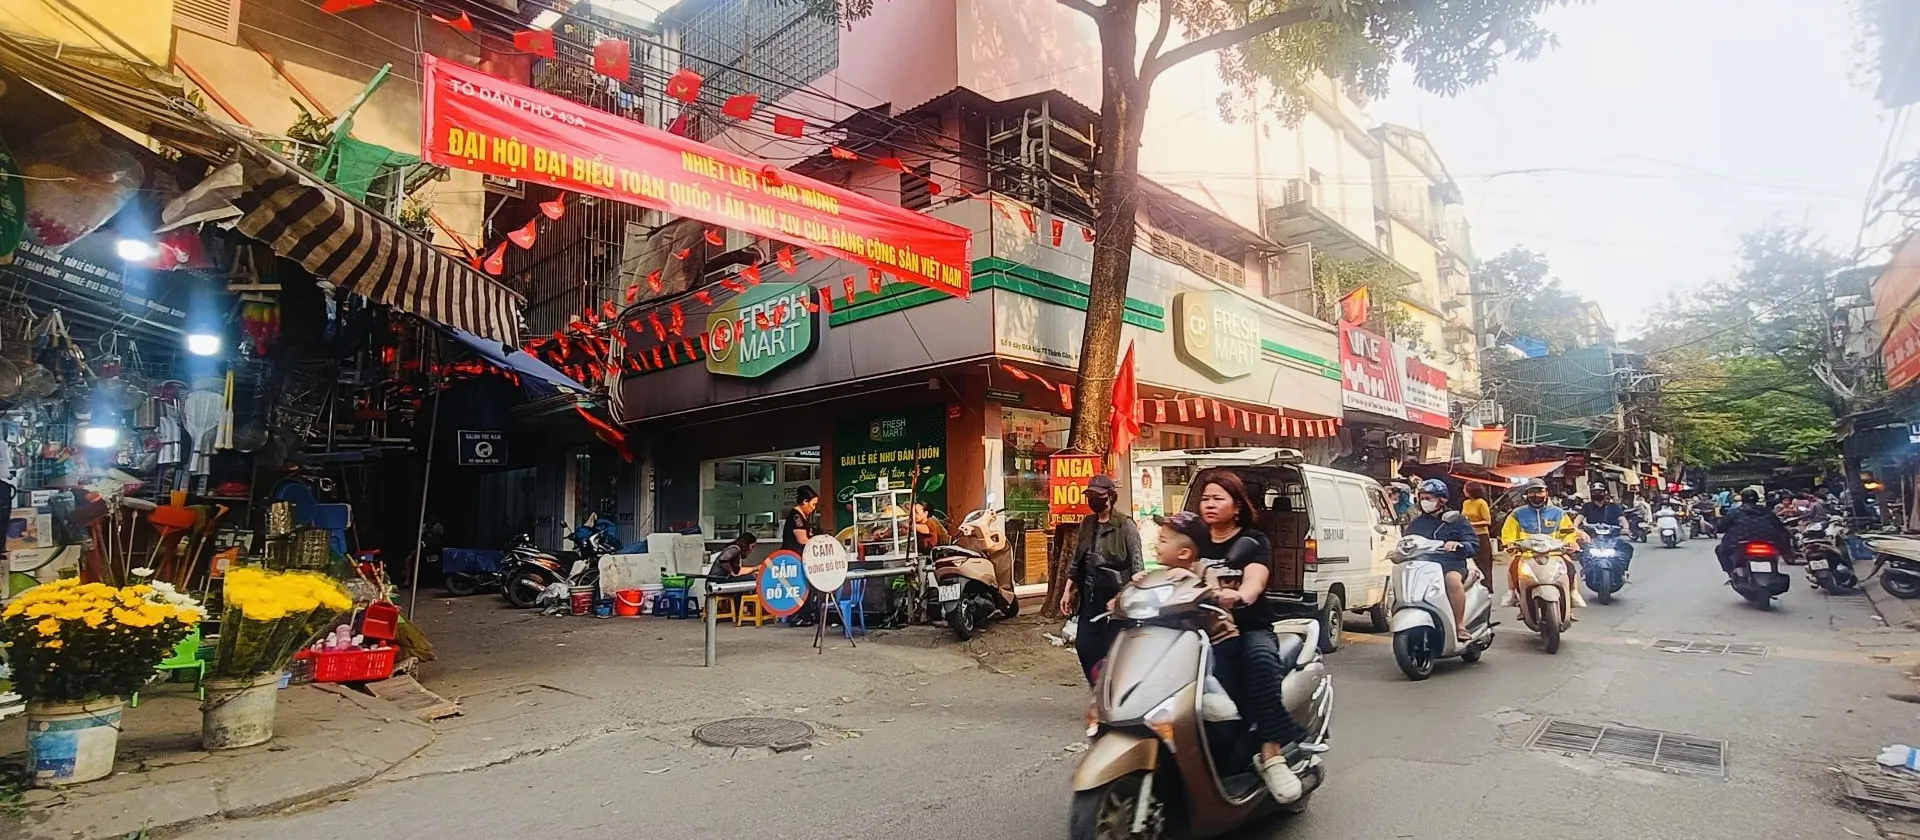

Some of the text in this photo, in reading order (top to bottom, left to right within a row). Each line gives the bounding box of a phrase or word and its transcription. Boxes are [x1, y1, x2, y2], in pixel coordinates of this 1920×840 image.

[480, 88, 515, 109] DÂN
[558, 111, 587, 128] 43A
[681, 150, 725, 183] NHIỆT
[729, 166, 758, 193] LIỆT
[448, 128, 962, 289] ĐẠI HỘI ĐẠI BIỂU TOÀN QUỐC LẦN THỨ XIV CỦA ĐẢNG CỘNG SẢN VIỆT NAM
[63, 256, 78, 270] BÁN
[84, 261, 97, 275] CÁC
[1189, 315, 1207, 336] CP
[1213, 308, 1261, 346] FRESH
[740, 322, 800, 363] MART
[1214, 335, 1256, 366] MART
[882, 419, 906, 428] FRESH
[882, 427, 904, 438] MART
[840, 453, 856, 467] BÁN
[879, 450, 896, 463] NHƯ
[897, 447, 914, 462] BÁN
[1056, 458, 1095, 478] NGA
[771, 560, 798, 578] CẤM
[766, 584, 800, 600] ĐỖ XE
